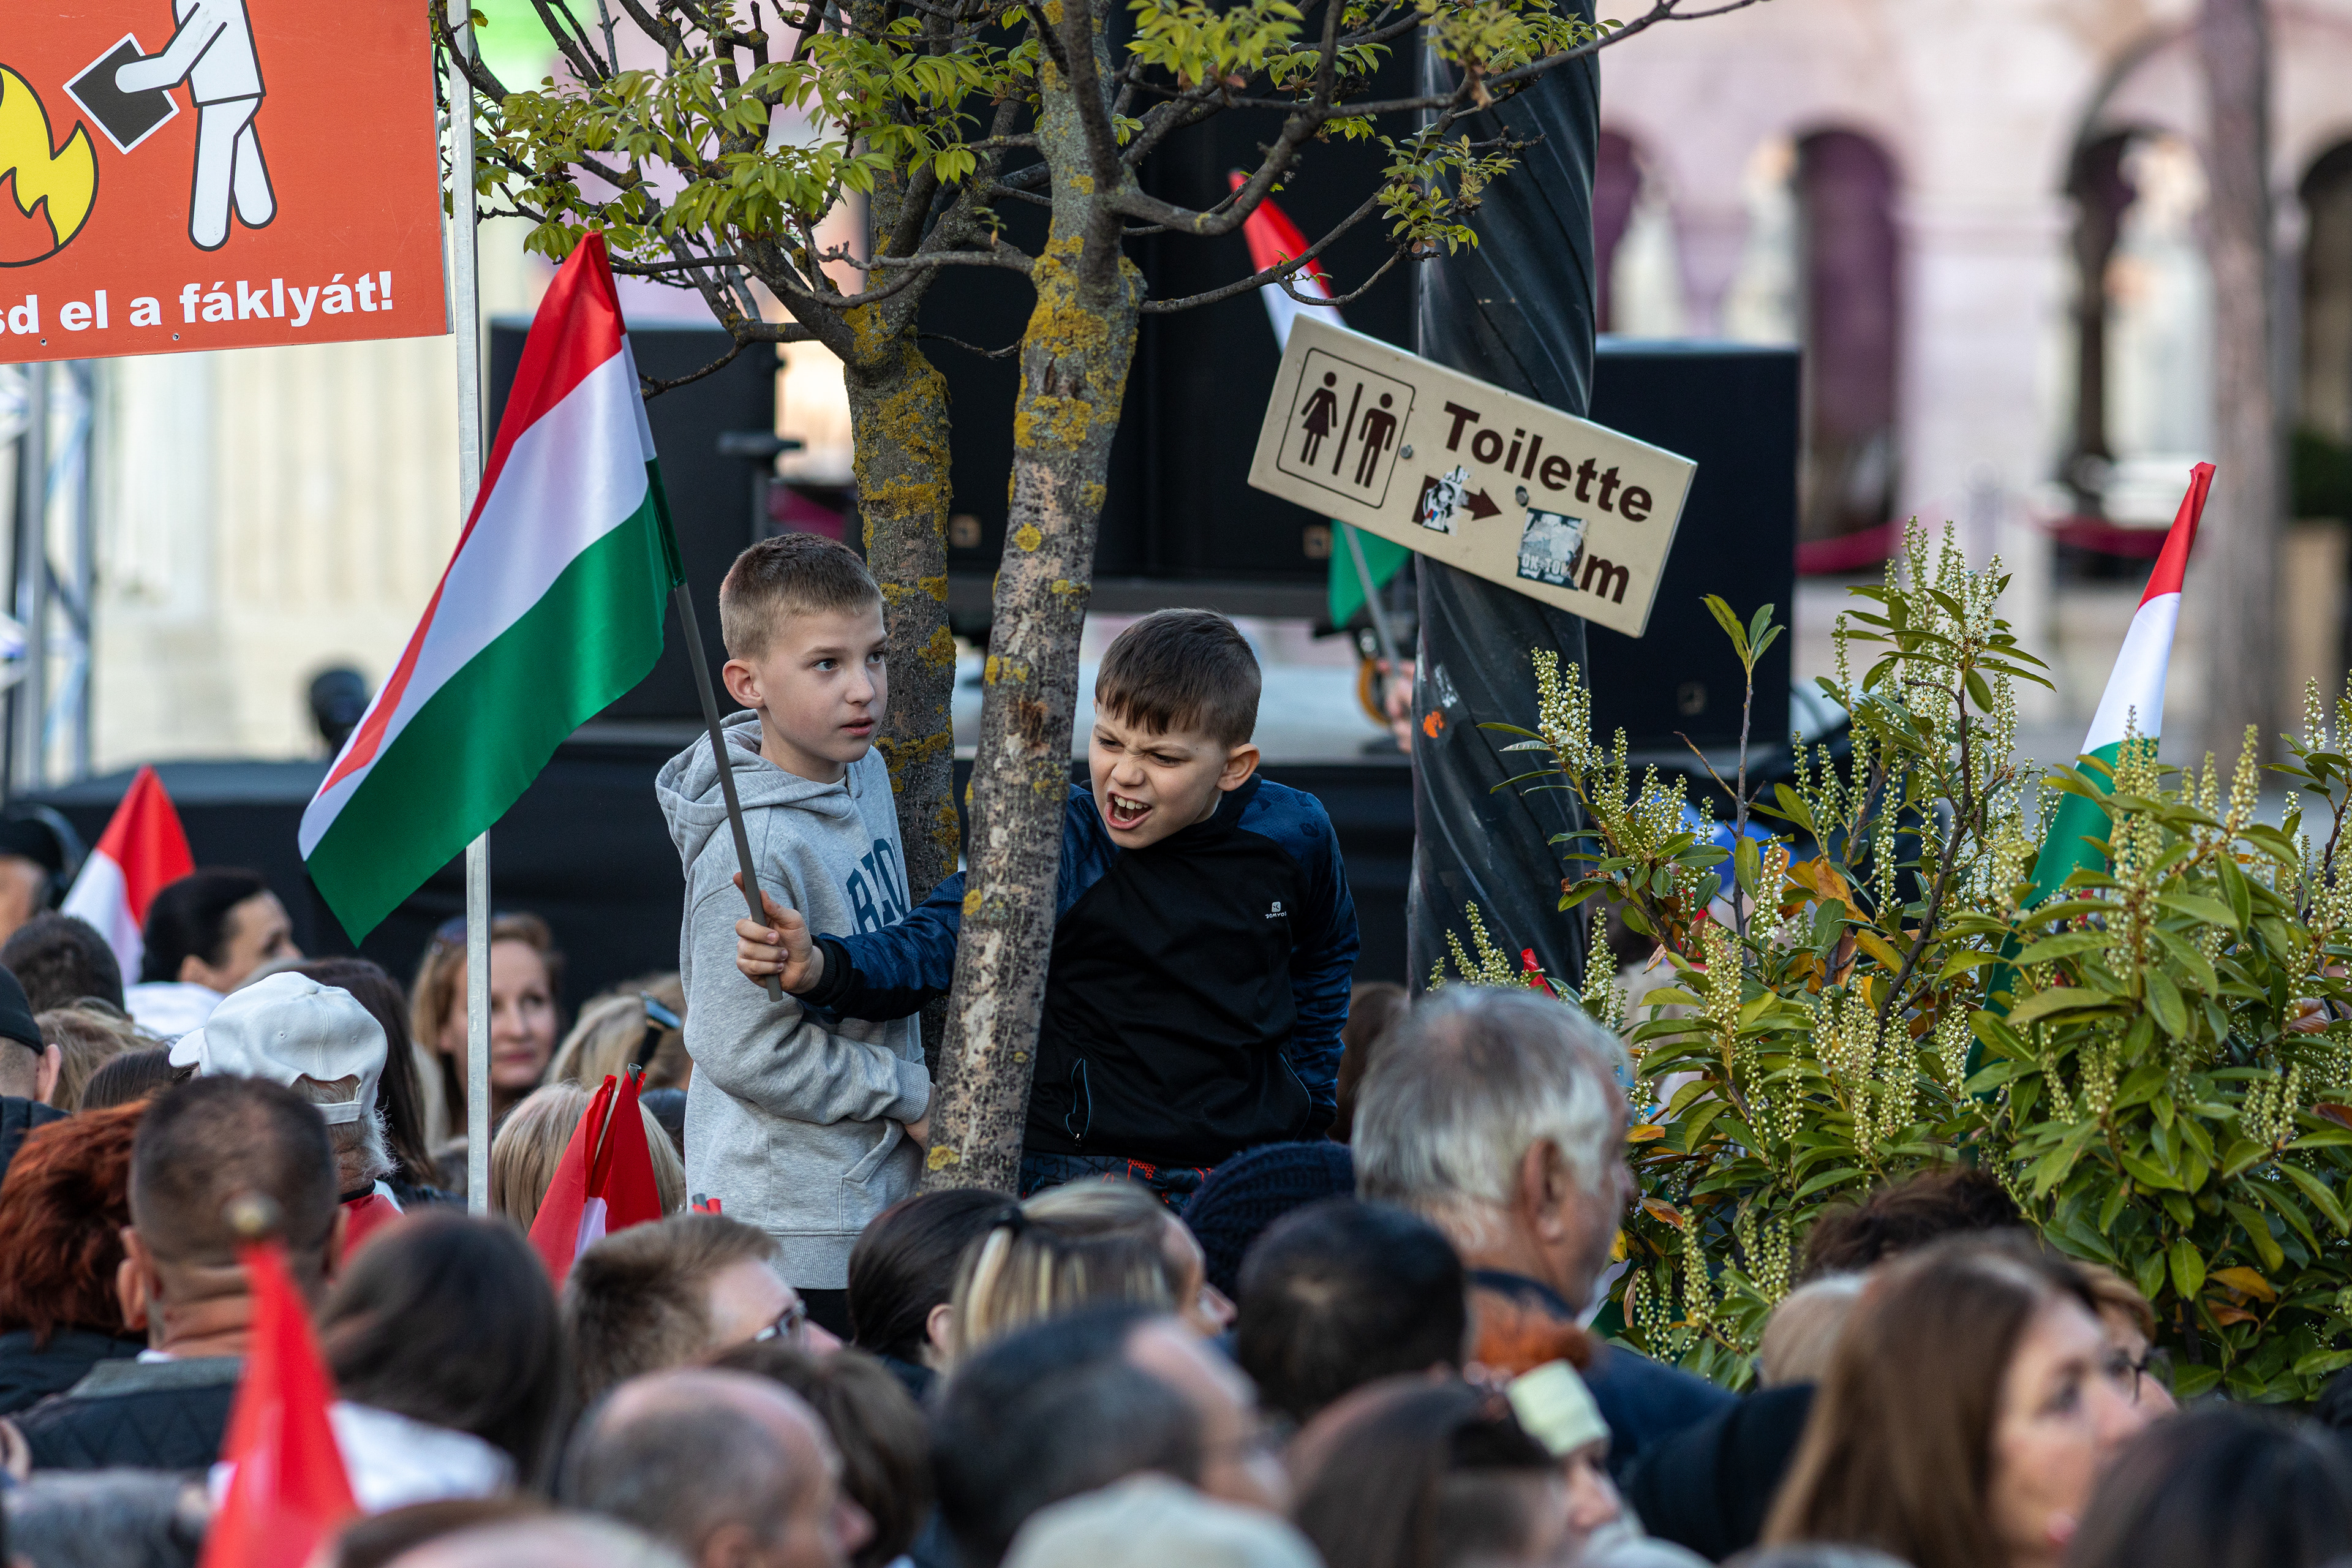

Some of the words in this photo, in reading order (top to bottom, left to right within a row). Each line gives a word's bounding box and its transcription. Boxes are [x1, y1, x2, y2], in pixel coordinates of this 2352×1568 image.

[0, 294, 40, 335] d
[59, 289, 108, 331] el
[129, 296, 162, 327] a
[179, 270, 394, 328] fáklyát!
[1444, 401, 1653, 522] Toilette
